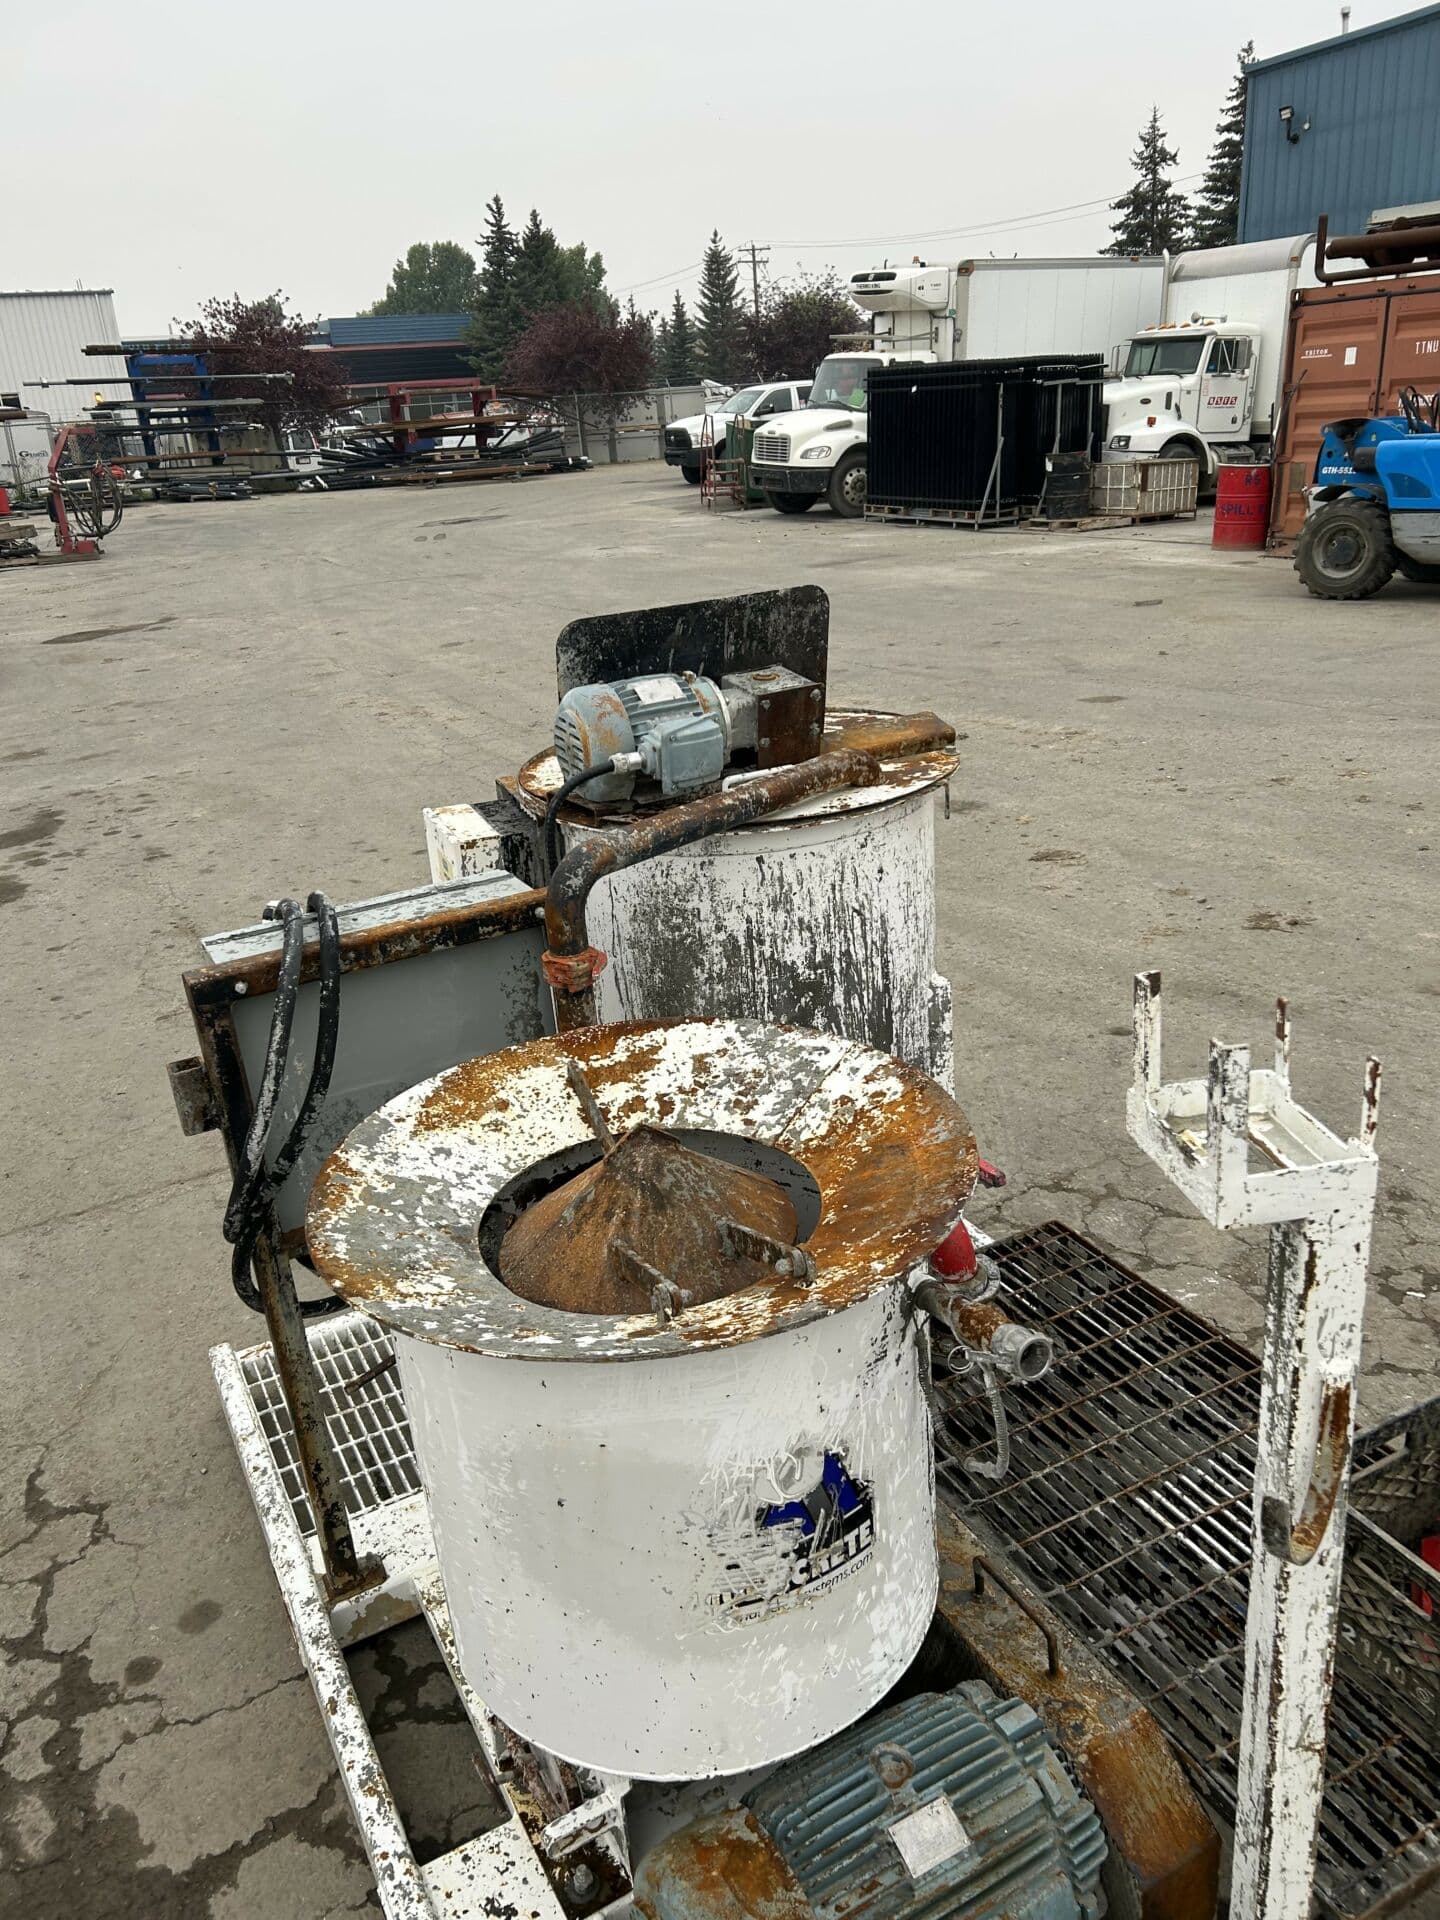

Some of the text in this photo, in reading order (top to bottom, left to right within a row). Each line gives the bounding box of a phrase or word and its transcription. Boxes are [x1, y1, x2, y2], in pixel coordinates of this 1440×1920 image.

[1415, 339, 1440, 355] TTNU
[1305, 348, 1329, 356] TRITON
[1321, 466, 1357, 475] GTH-551
